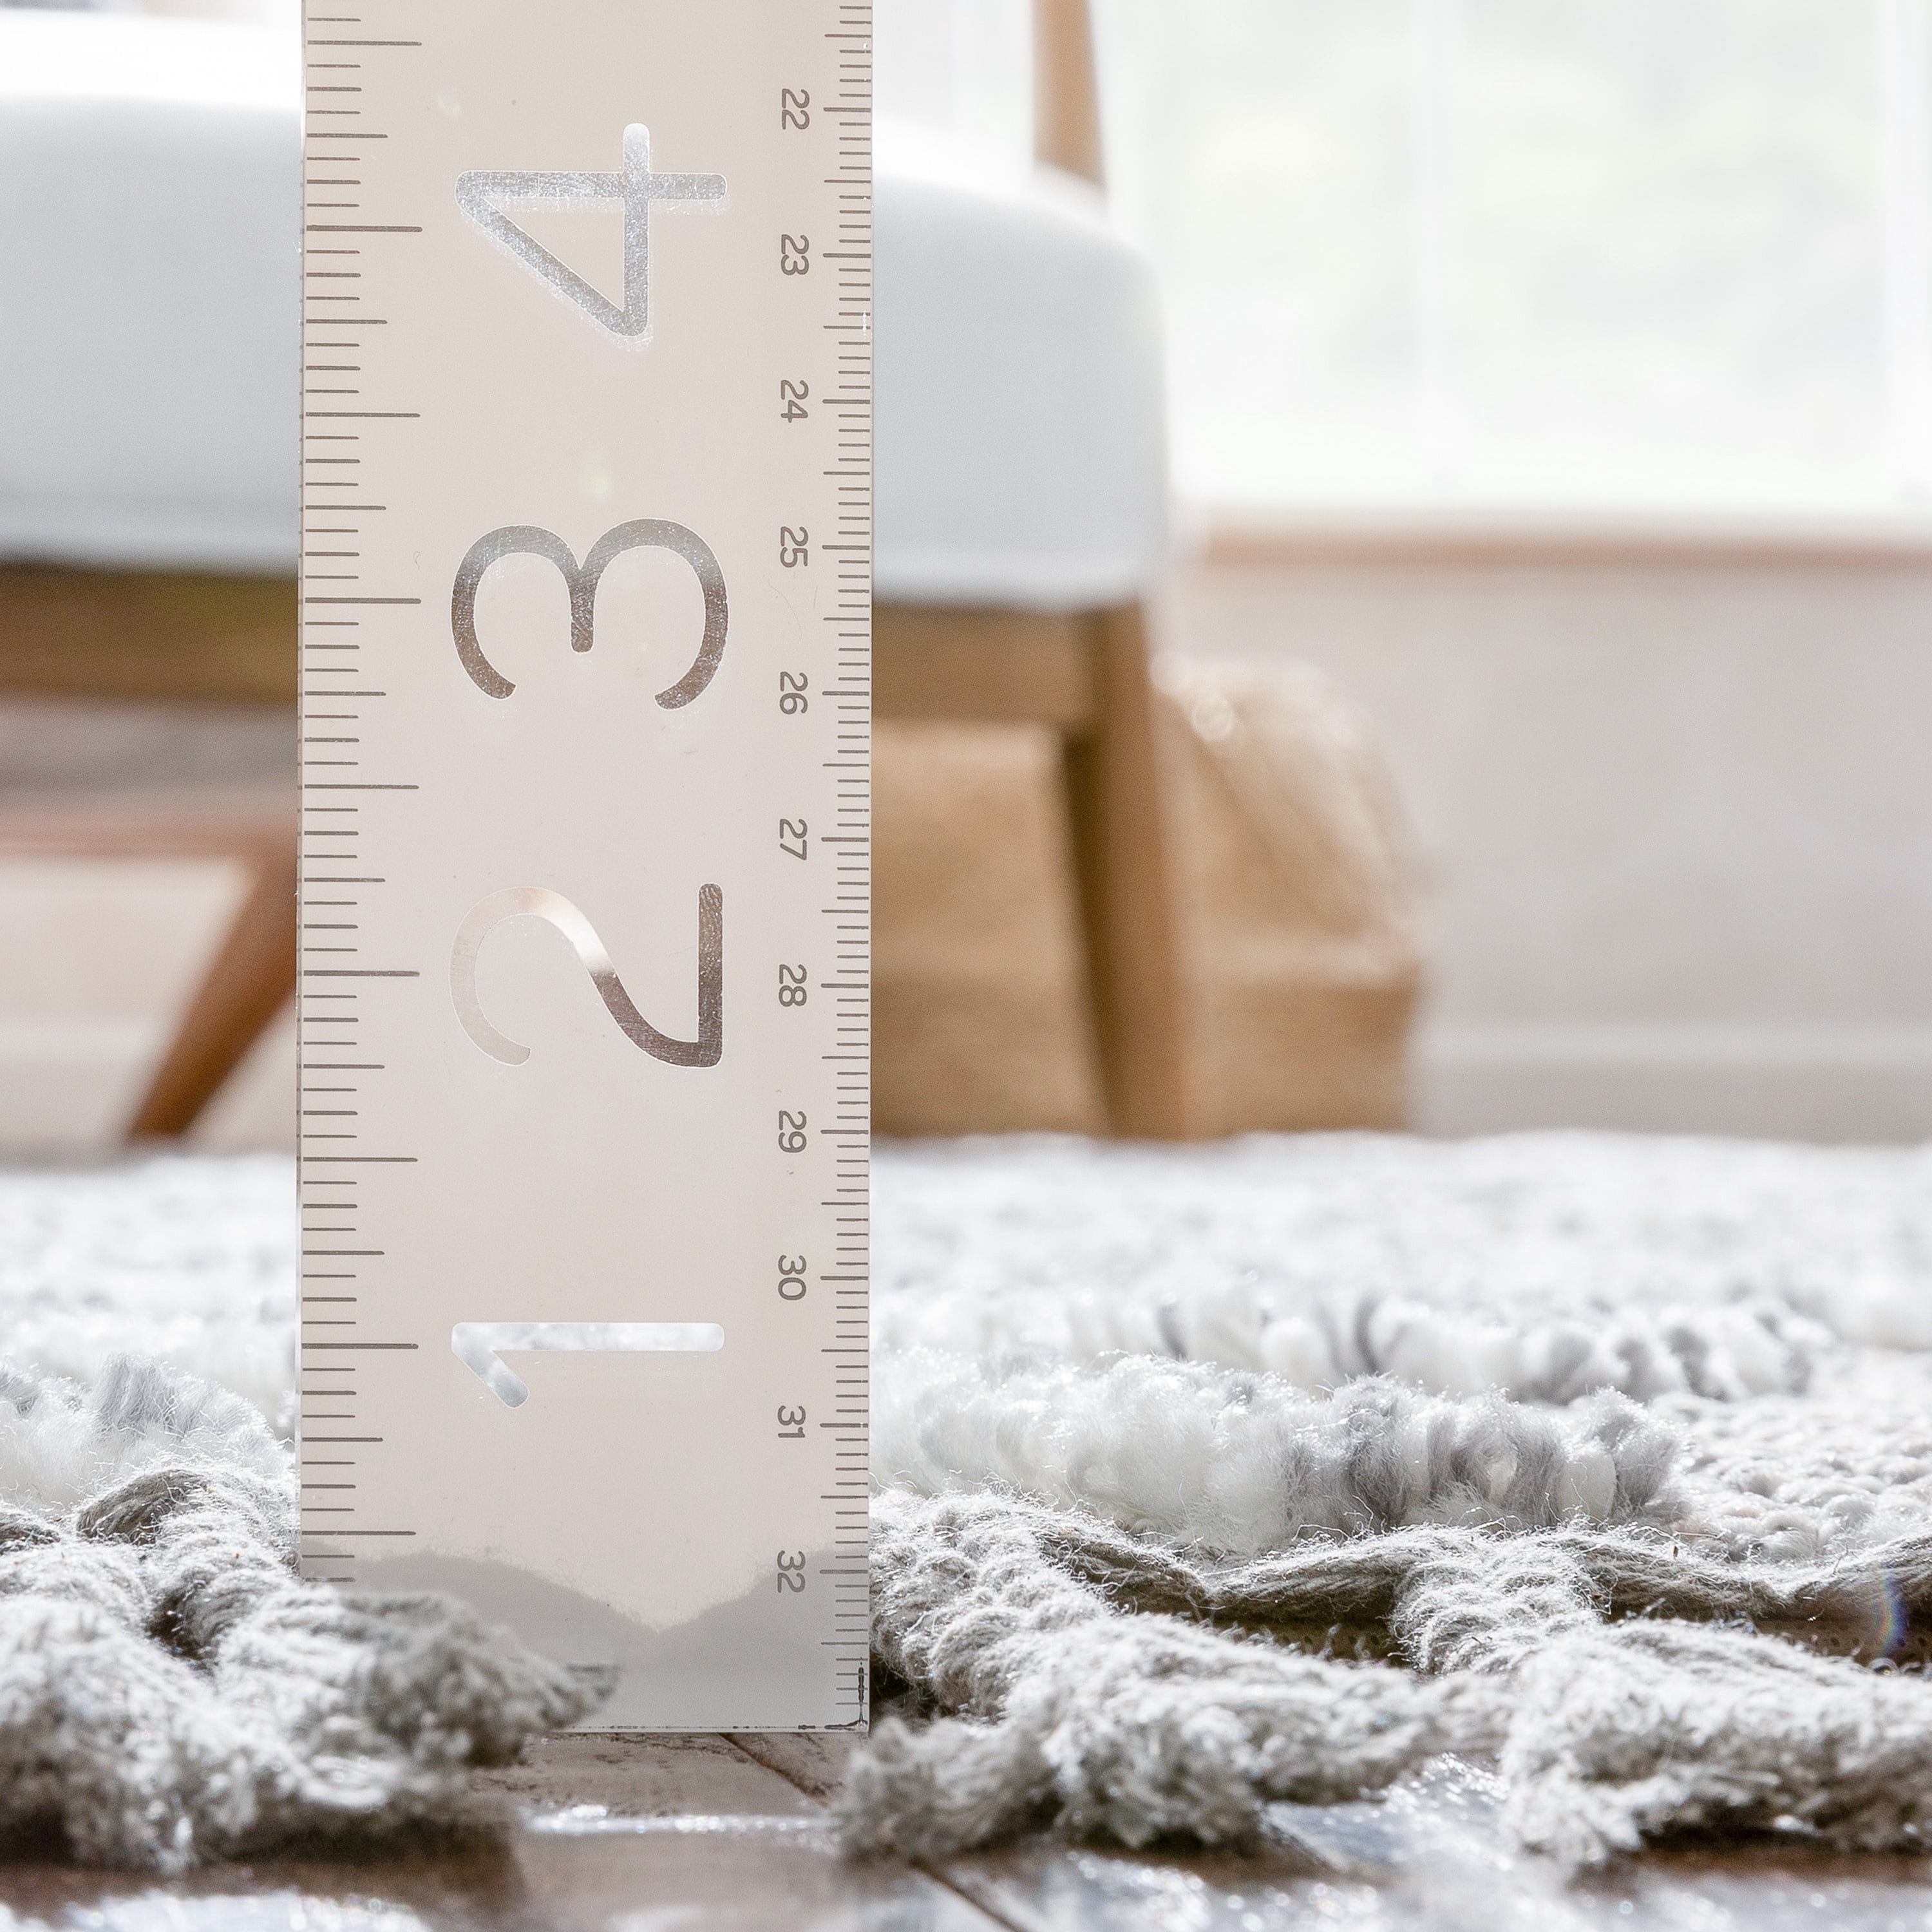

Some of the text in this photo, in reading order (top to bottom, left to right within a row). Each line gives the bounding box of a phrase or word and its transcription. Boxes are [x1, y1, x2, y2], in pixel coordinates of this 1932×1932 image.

[781, 88, 810, 130] 22
[455, 122, 728, 337] 4
[780, 234, 810, 276] 23
[780, 379, 810, 424] 24
[779, 526, 809, 568] 25
[450, 518, 729, 710] 3
[779, 671, 809, 715] 26
[779, 818, 808, 861] 27
[449, 883, 723, 1068] 2
[778, 963, 808, 1007] 28
[777, 1110, 808, 1153] 29
[777, 1254, 807, 1301] 30
[451, 1322, 725, 1408] 1
[777, 1405, 806, 1439] 31
[777, 1549, 806, 1593] 32
